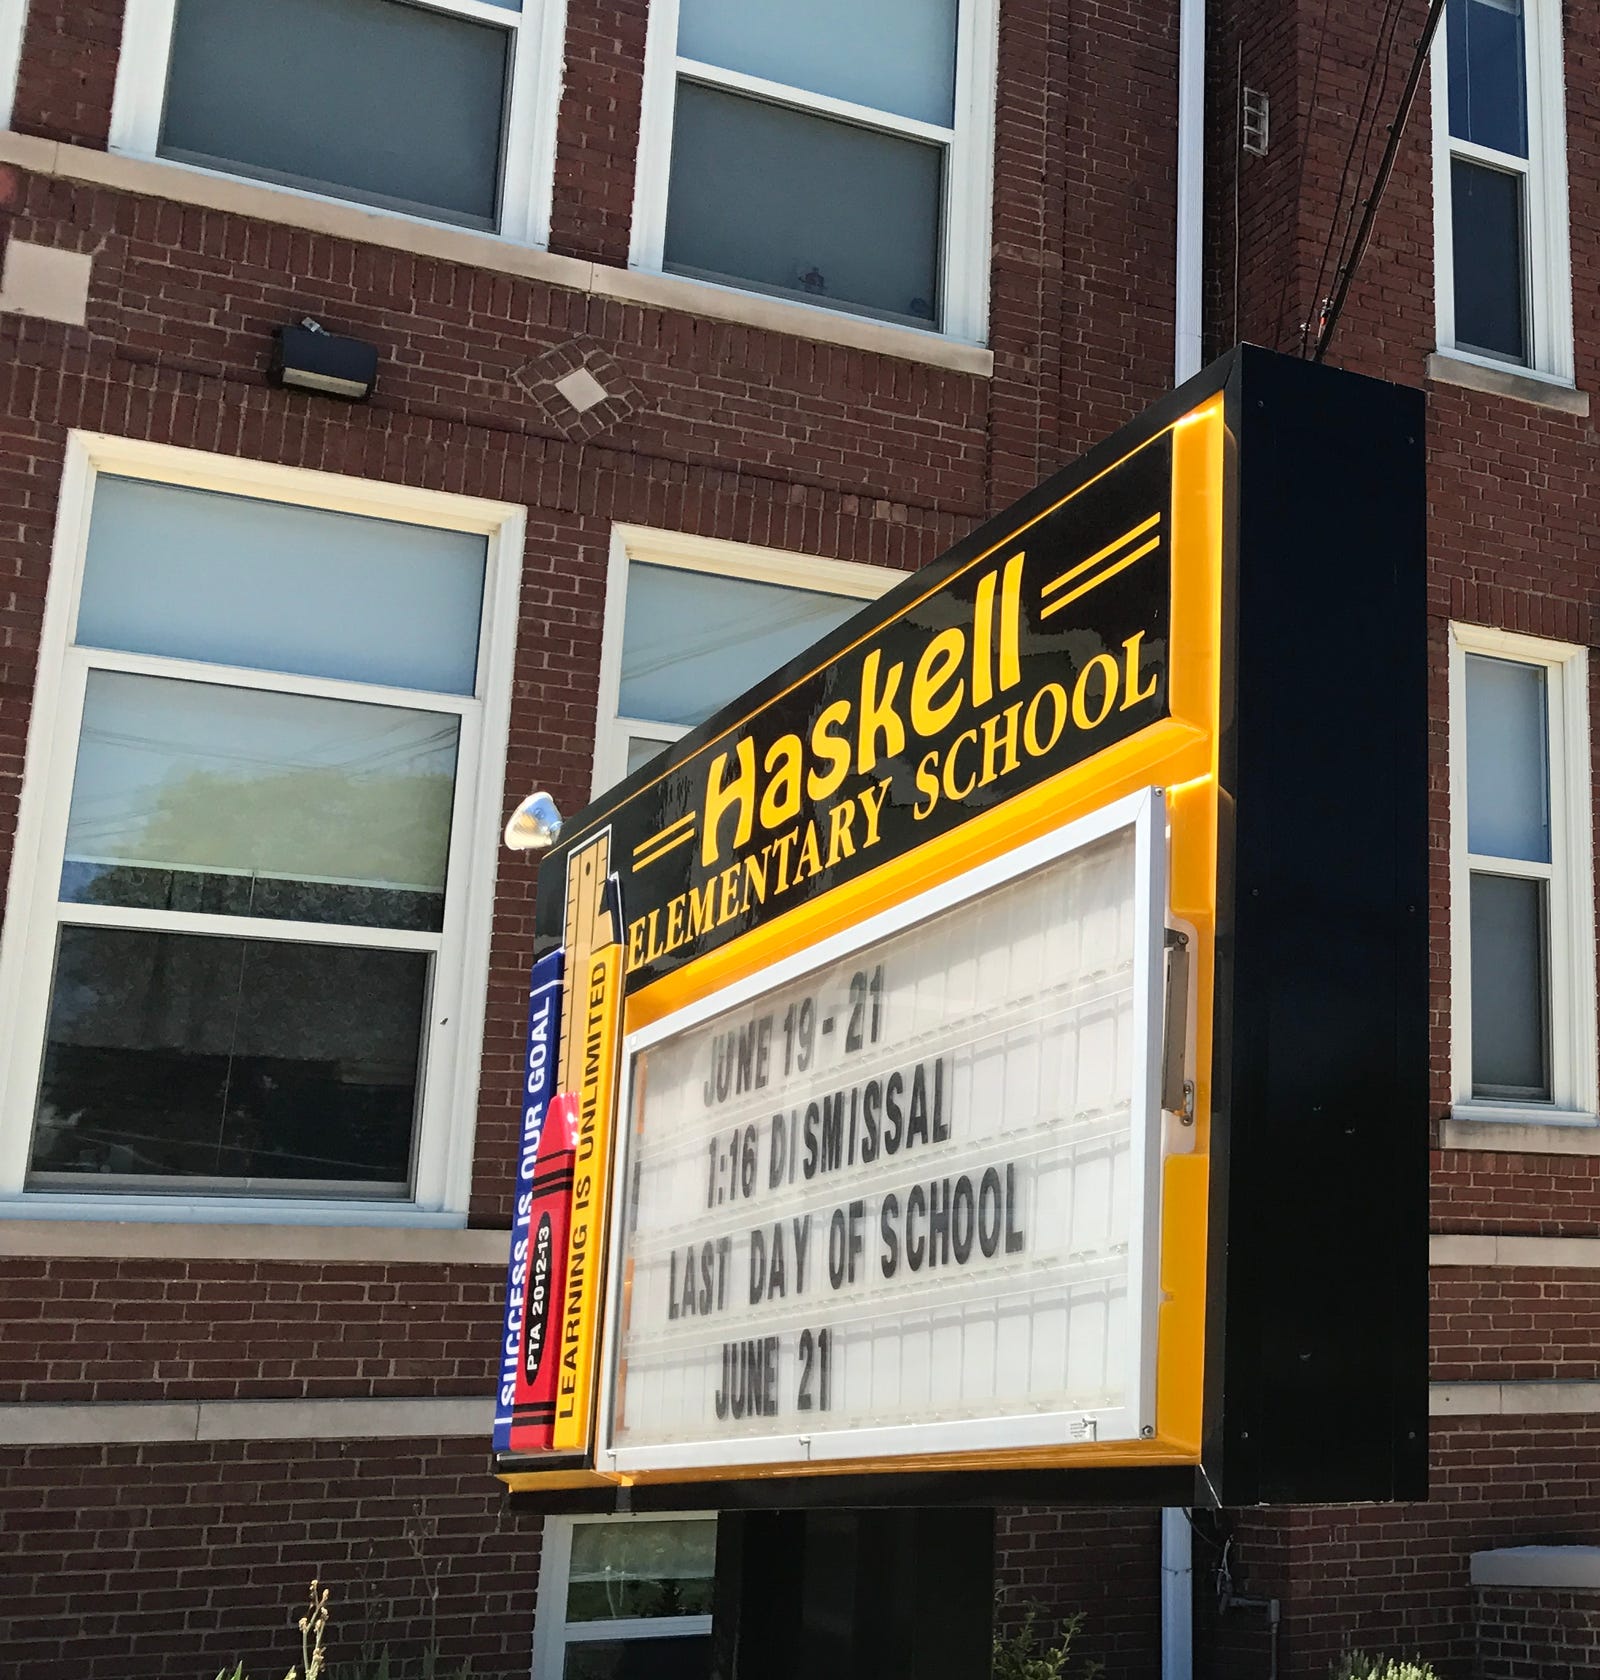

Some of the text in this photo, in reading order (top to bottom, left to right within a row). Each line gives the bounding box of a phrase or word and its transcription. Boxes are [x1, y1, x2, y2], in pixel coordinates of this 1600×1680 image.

[700, 550, 1026, 867] Haskell
[626, 629, 1158, 975] ELEMENTARY SCHOOL
[703, 1014, 774, 1108] JUNE
[706, 1056, 951, 1210] 1:16 DISMISSAL
[501, 996, 550, 1407] SUCCESS IS OUR GOAL
[559, 959, 607, 1419] LEARNING IS UNLIMITED
[667, 1162, 1024, 1321] LAST DAY OF SCHOOL
[526, 1225, 550, 1372] PTA 2012-13
[714, 1327, 830, 1421] JUNE 21
